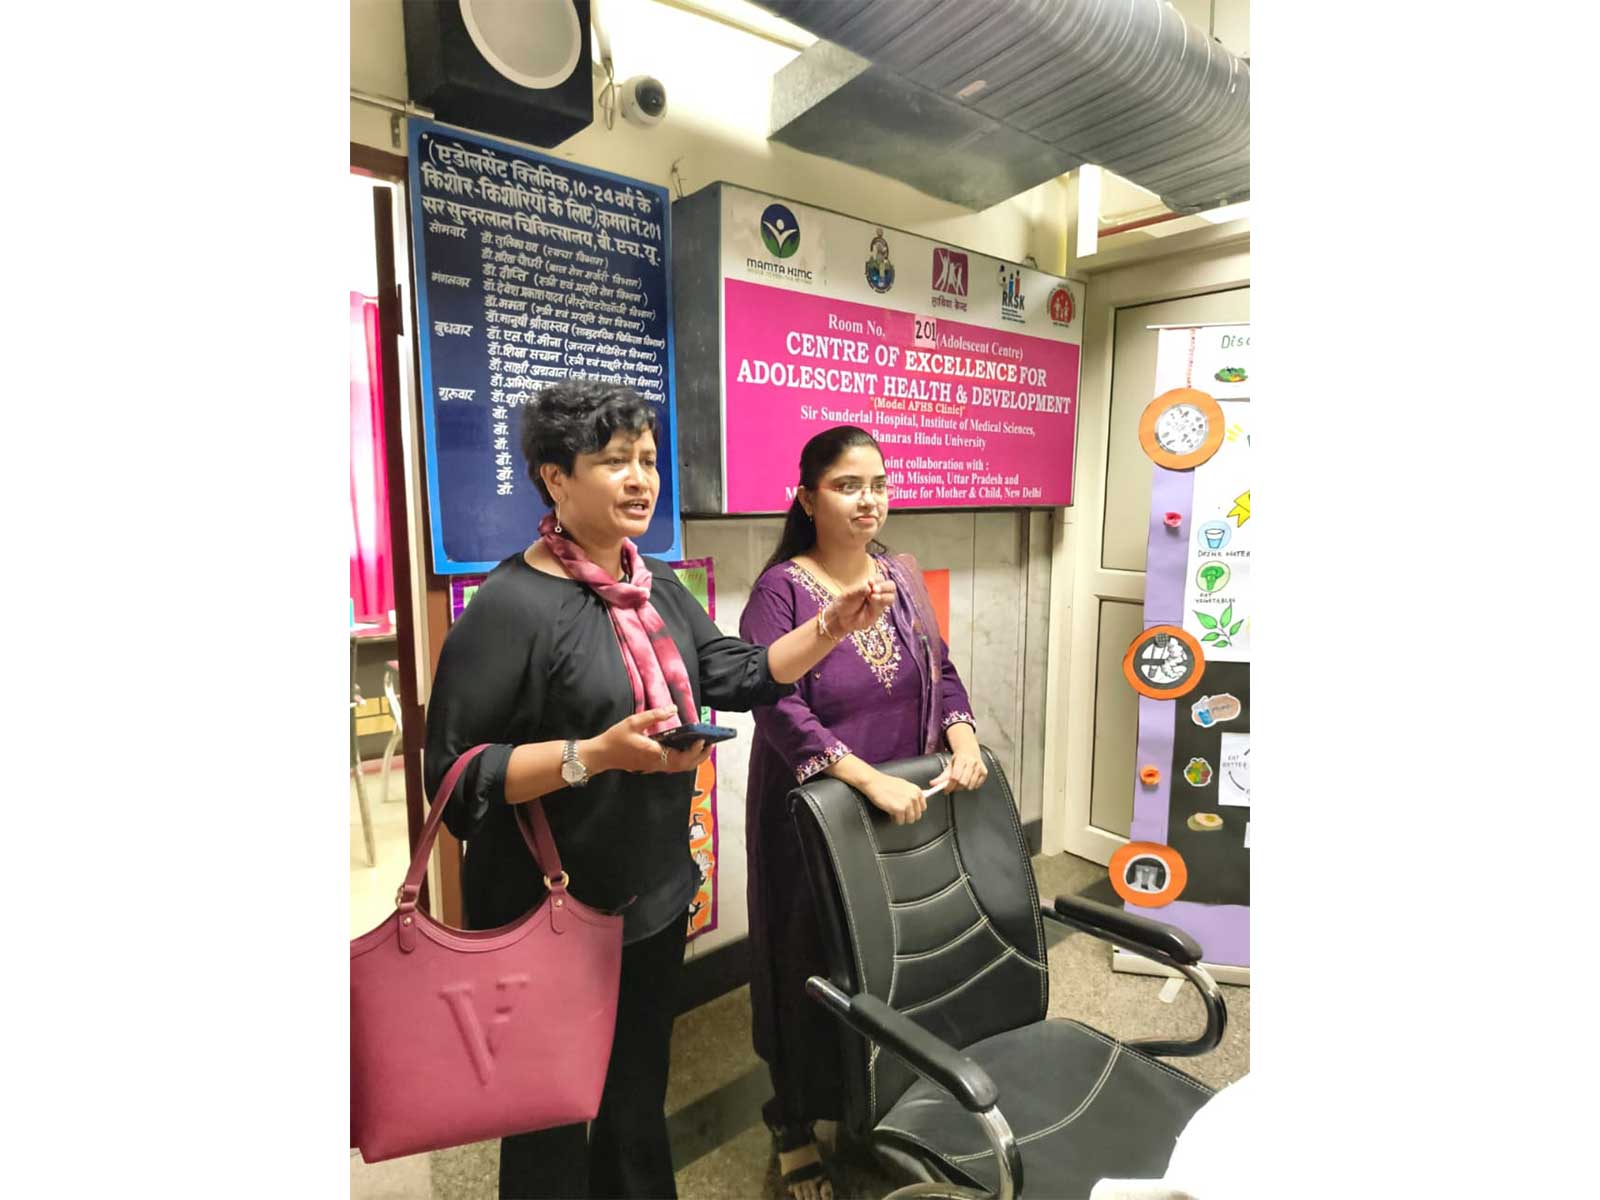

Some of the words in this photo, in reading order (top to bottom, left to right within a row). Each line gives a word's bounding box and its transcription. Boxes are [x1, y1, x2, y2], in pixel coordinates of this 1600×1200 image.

[548, 191, 563, 217] के
[615, 187, 634, 209] वर्ष
[636, 190, 652, 213] के
[421, 195, 446, 215] सर
[447, 200, 513, 230] सुन्दरलाल
[430, 219, 467, 239] सोमवार
[434, 321, 473, 337] बुधवार
[828, 314, 863, 334] Room
[867, 320, 886, 337] No.
[915, 320, 936, 341] 201
[937, 334, 989, 355] (Adolescent
[992, 343, 1024, 361] Centre)
[786, 331, 870, 364] CENTRE
[875, 345, 900, 367] OF
[905, 350, 1017, 383] EXCELLENCE
[1019, 365, 1047, 388] FOR
[737, 359, 878, 395] ADOLESCENT
[883, 375, 952, 401] HEALTH
[956, 384, 968, 405] &
[972, 386, 1072, 415] DEVELOPMENT
[908, 401, 933, 413] AFHS
[801, 405, 818, 420] Sir
[821, 407, 873, 424] Sunderlal
[876, 411, 918, 429] Hospital,
[921, 415, 957, 431] Institute
[959, 419, 969, 431] of
[970, 419, 1001, 433] Medical
[1003, 421, 1036, 437] Sciences,
[872, 429, 911, 444] Banaras
[914, 432, 942, 446] Hindu
[945, 434, 986, 451] University
[883, 455, 903, 469] oint
[905, 456, 963, 471] collaboration
[966, 459, 984, 471] with
[907, 472, 944, 486] Mission,
[947, 474, 969, 486] Uttar
[971, 474, 1002, 487] Pradesh
[1004, 474, 1019, 486] and
[920, 486, 932, 499] for
[936, 486, 967, 500] Mother
[968, 487, 975, 499] &
[978, 487, 1002, 500] Child,
[1005, 487, 1021, 499] New
[1023, 486, 1042, 499] Delhi
